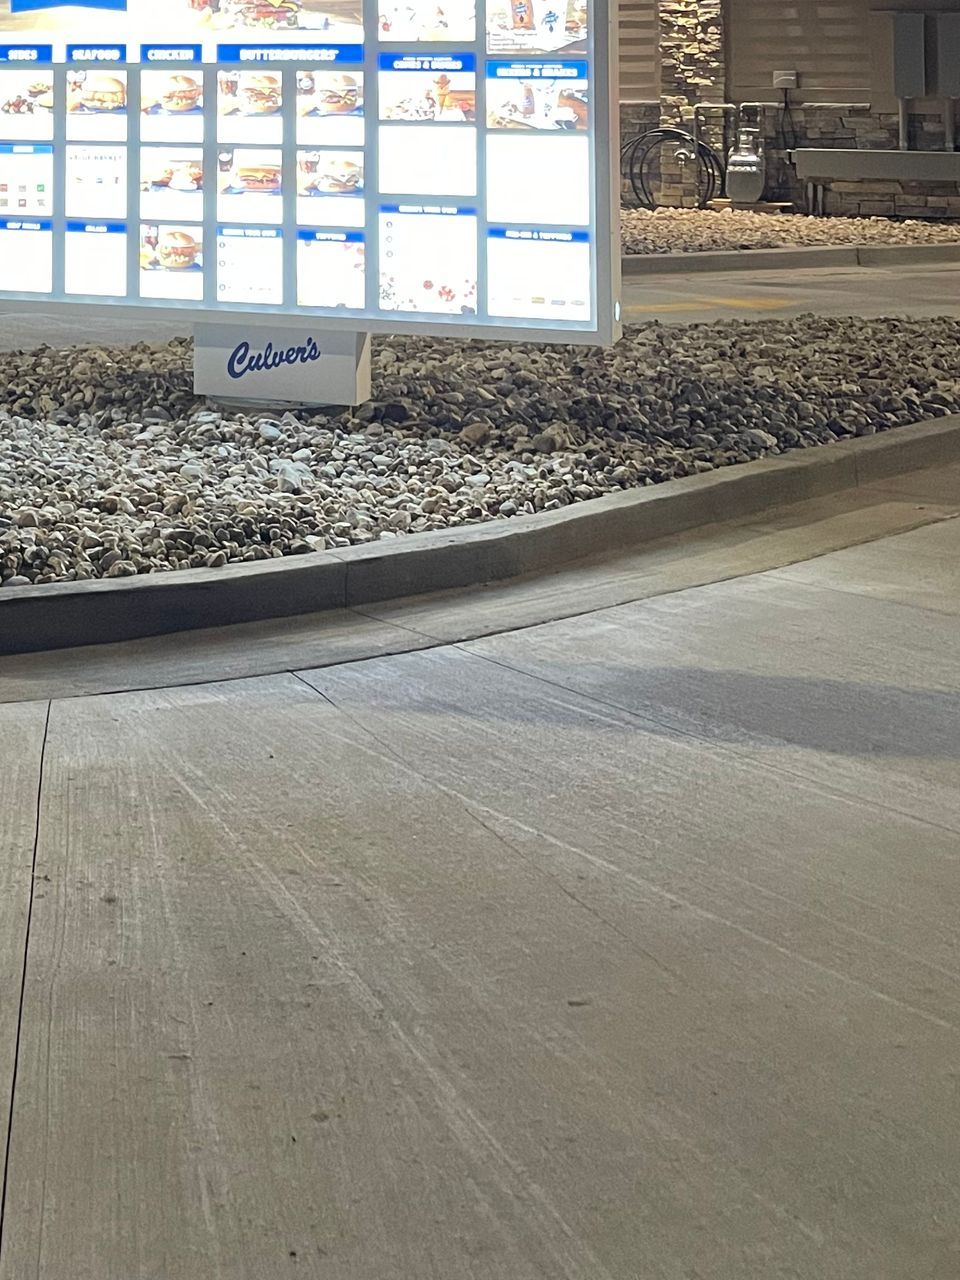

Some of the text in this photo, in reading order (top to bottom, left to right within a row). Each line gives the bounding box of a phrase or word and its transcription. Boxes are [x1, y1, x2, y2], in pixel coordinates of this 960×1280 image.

[72, 49, 121, 61] SEAFOOD
[147, 49, 194, 60] CHICKEN
[227, 337, 321, 379] Culver's
